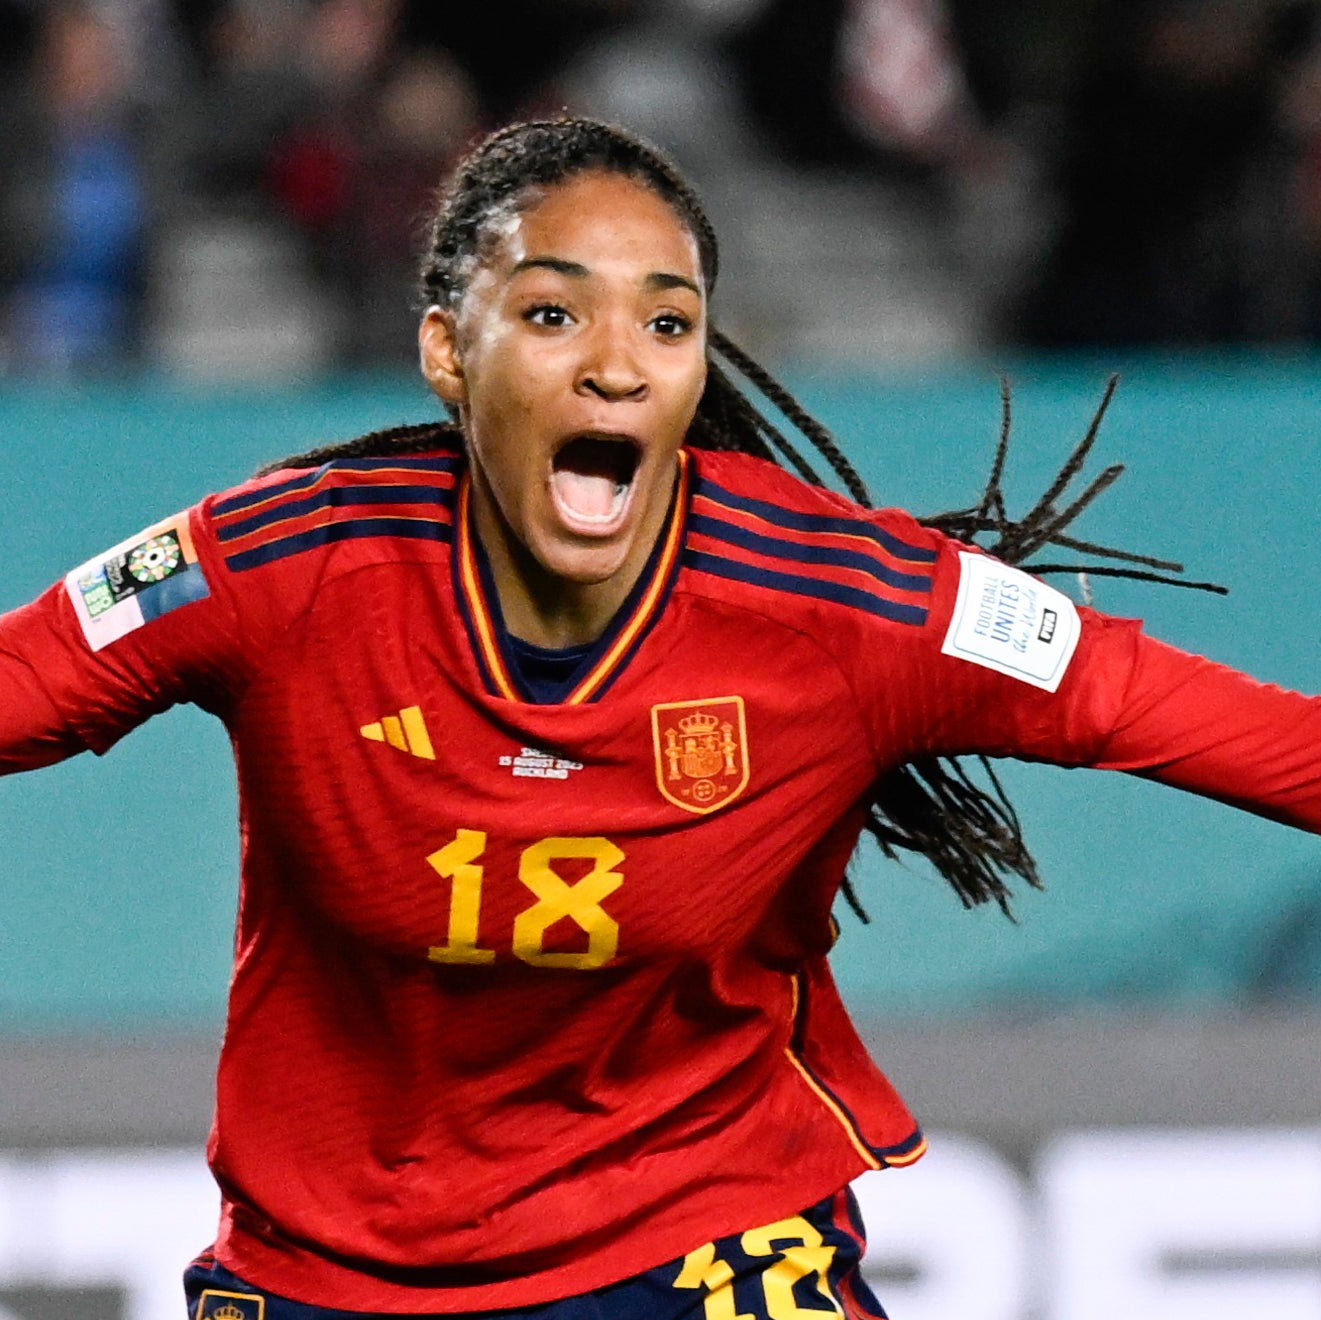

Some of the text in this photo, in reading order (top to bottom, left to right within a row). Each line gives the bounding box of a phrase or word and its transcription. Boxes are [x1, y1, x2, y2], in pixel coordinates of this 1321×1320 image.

[974, 575, 1000, 637] FOOTBALL
[990, 579, 1020, 643] UNITES
[426, 828, 626, 970] 18
